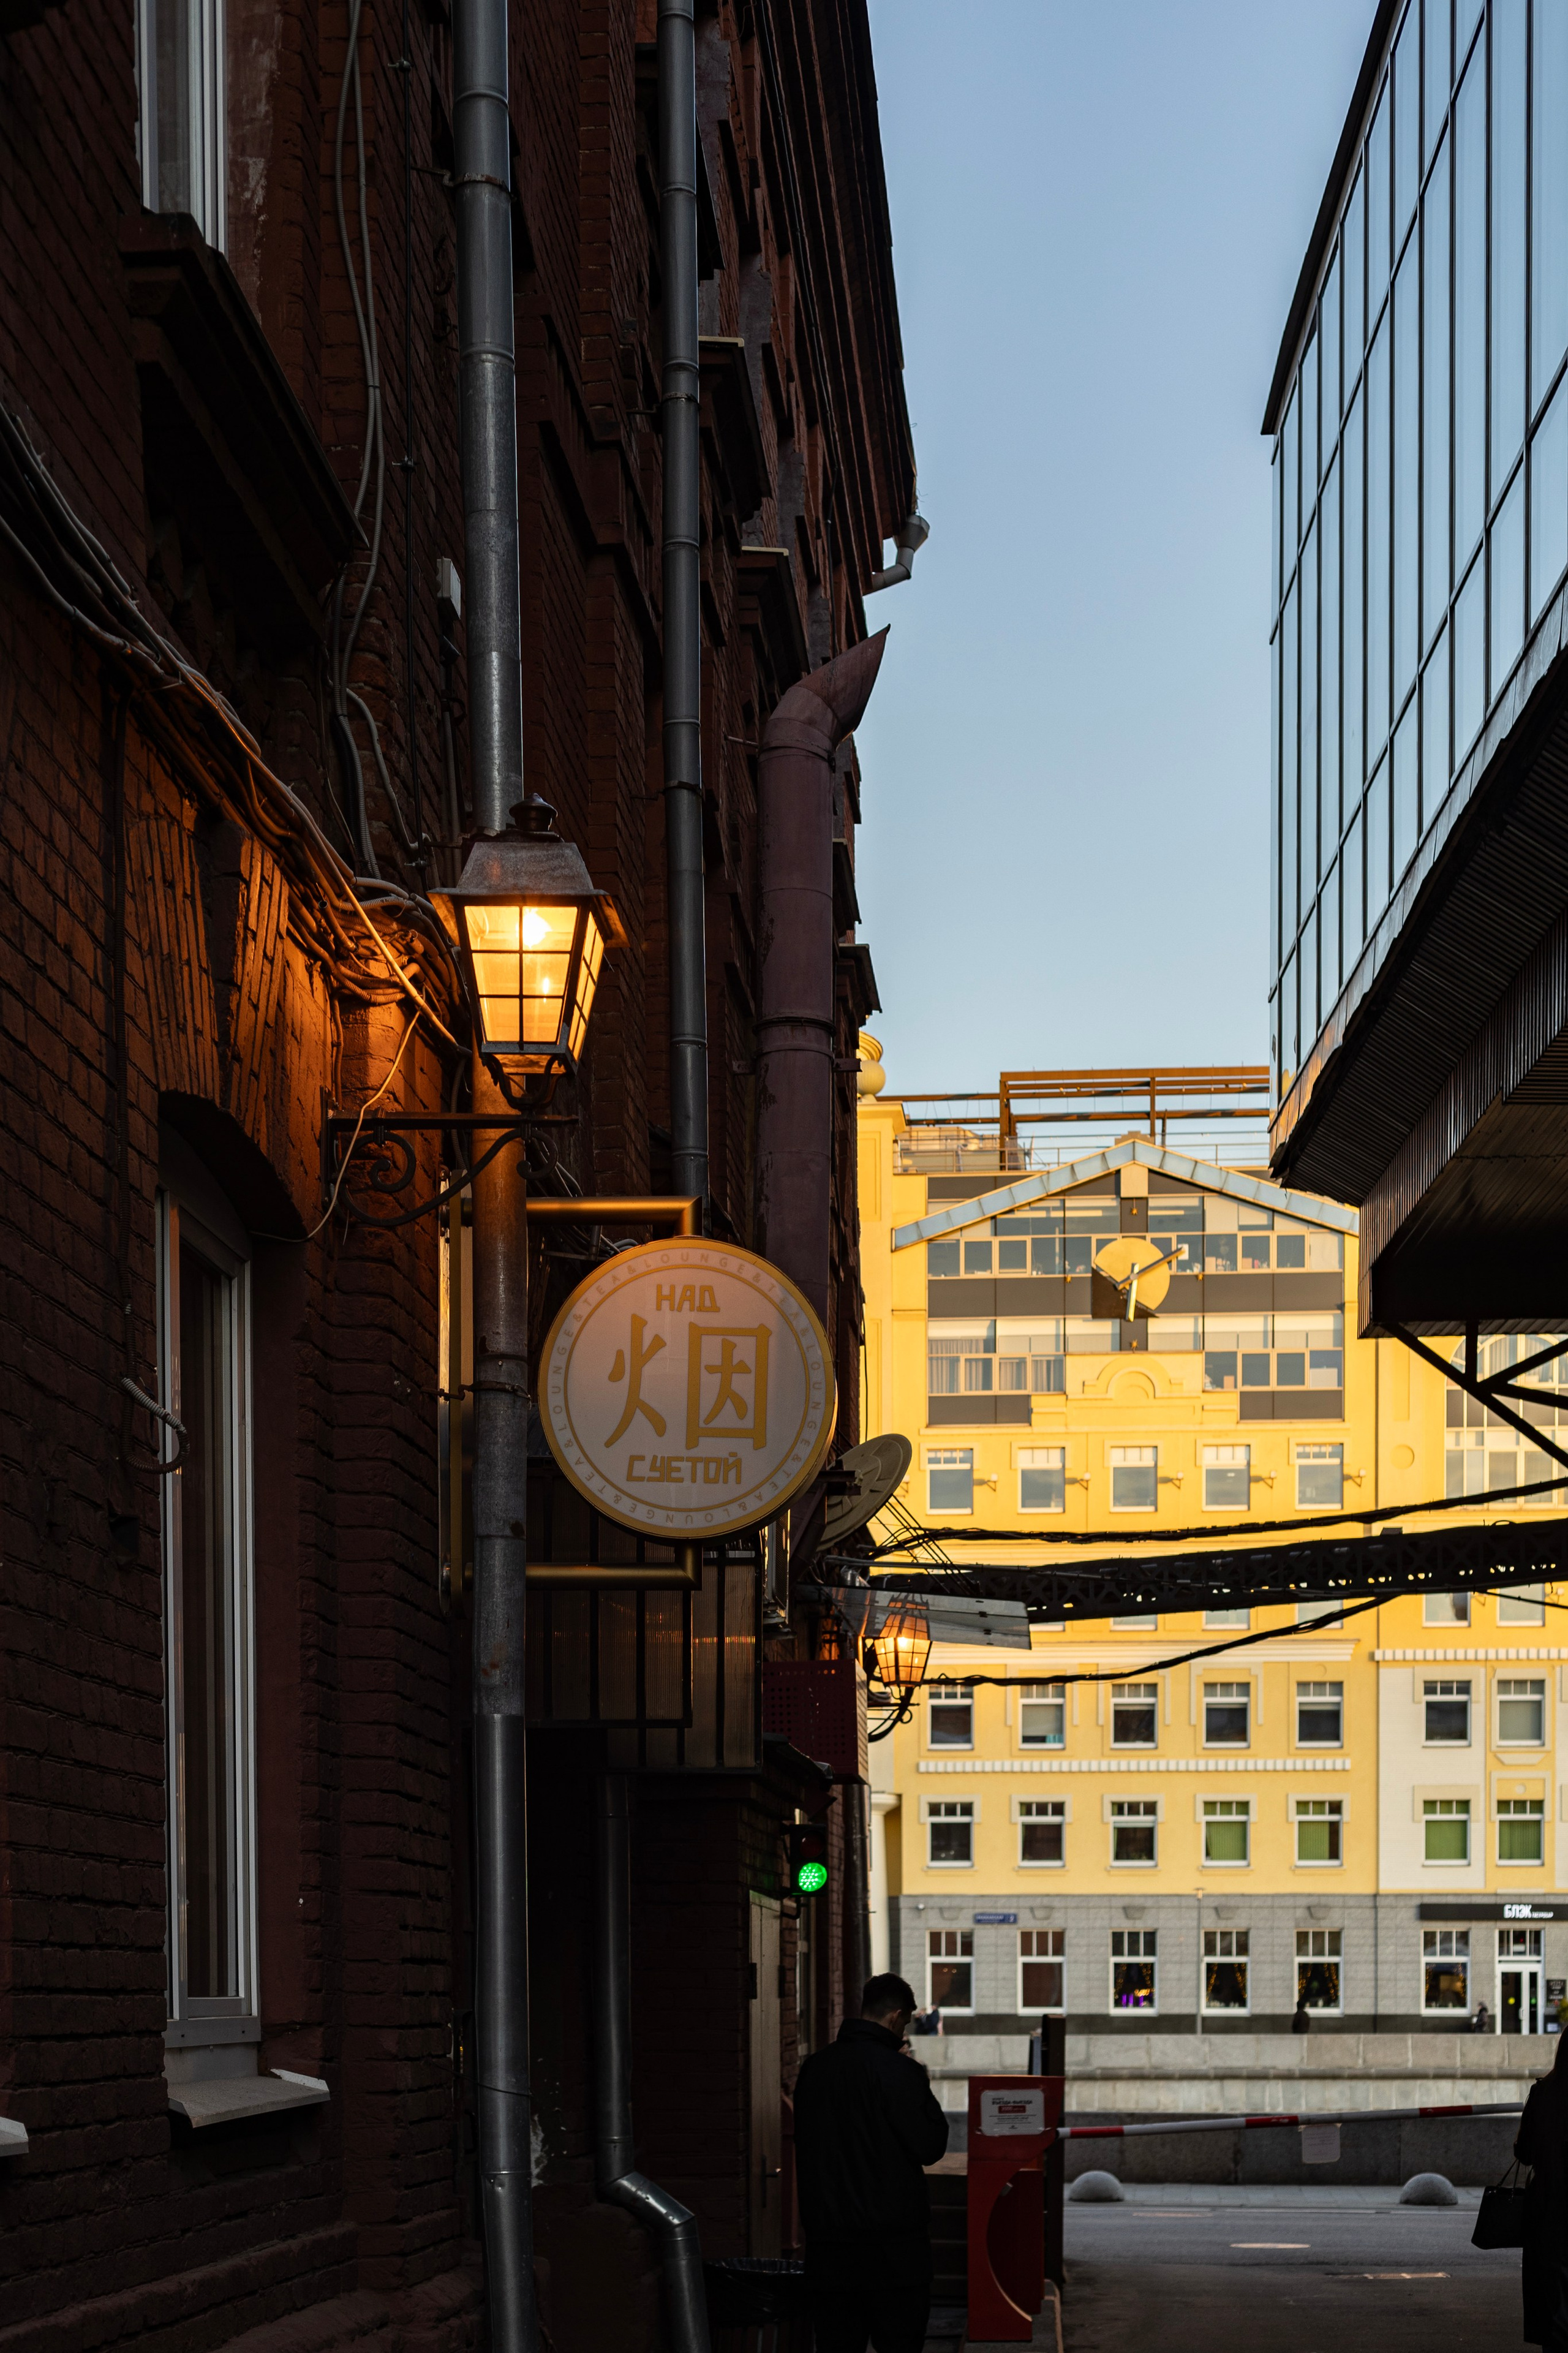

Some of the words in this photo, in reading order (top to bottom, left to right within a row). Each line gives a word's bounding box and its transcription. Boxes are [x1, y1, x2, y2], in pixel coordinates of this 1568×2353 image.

[656, 1283, 720, 1312] НАД
[604, 1313, 772, 1451] 烟
[626, 1452, 742, 1484] СУЕТОЙ
[1504, 1904, 1532, 1918] БЛЭК
